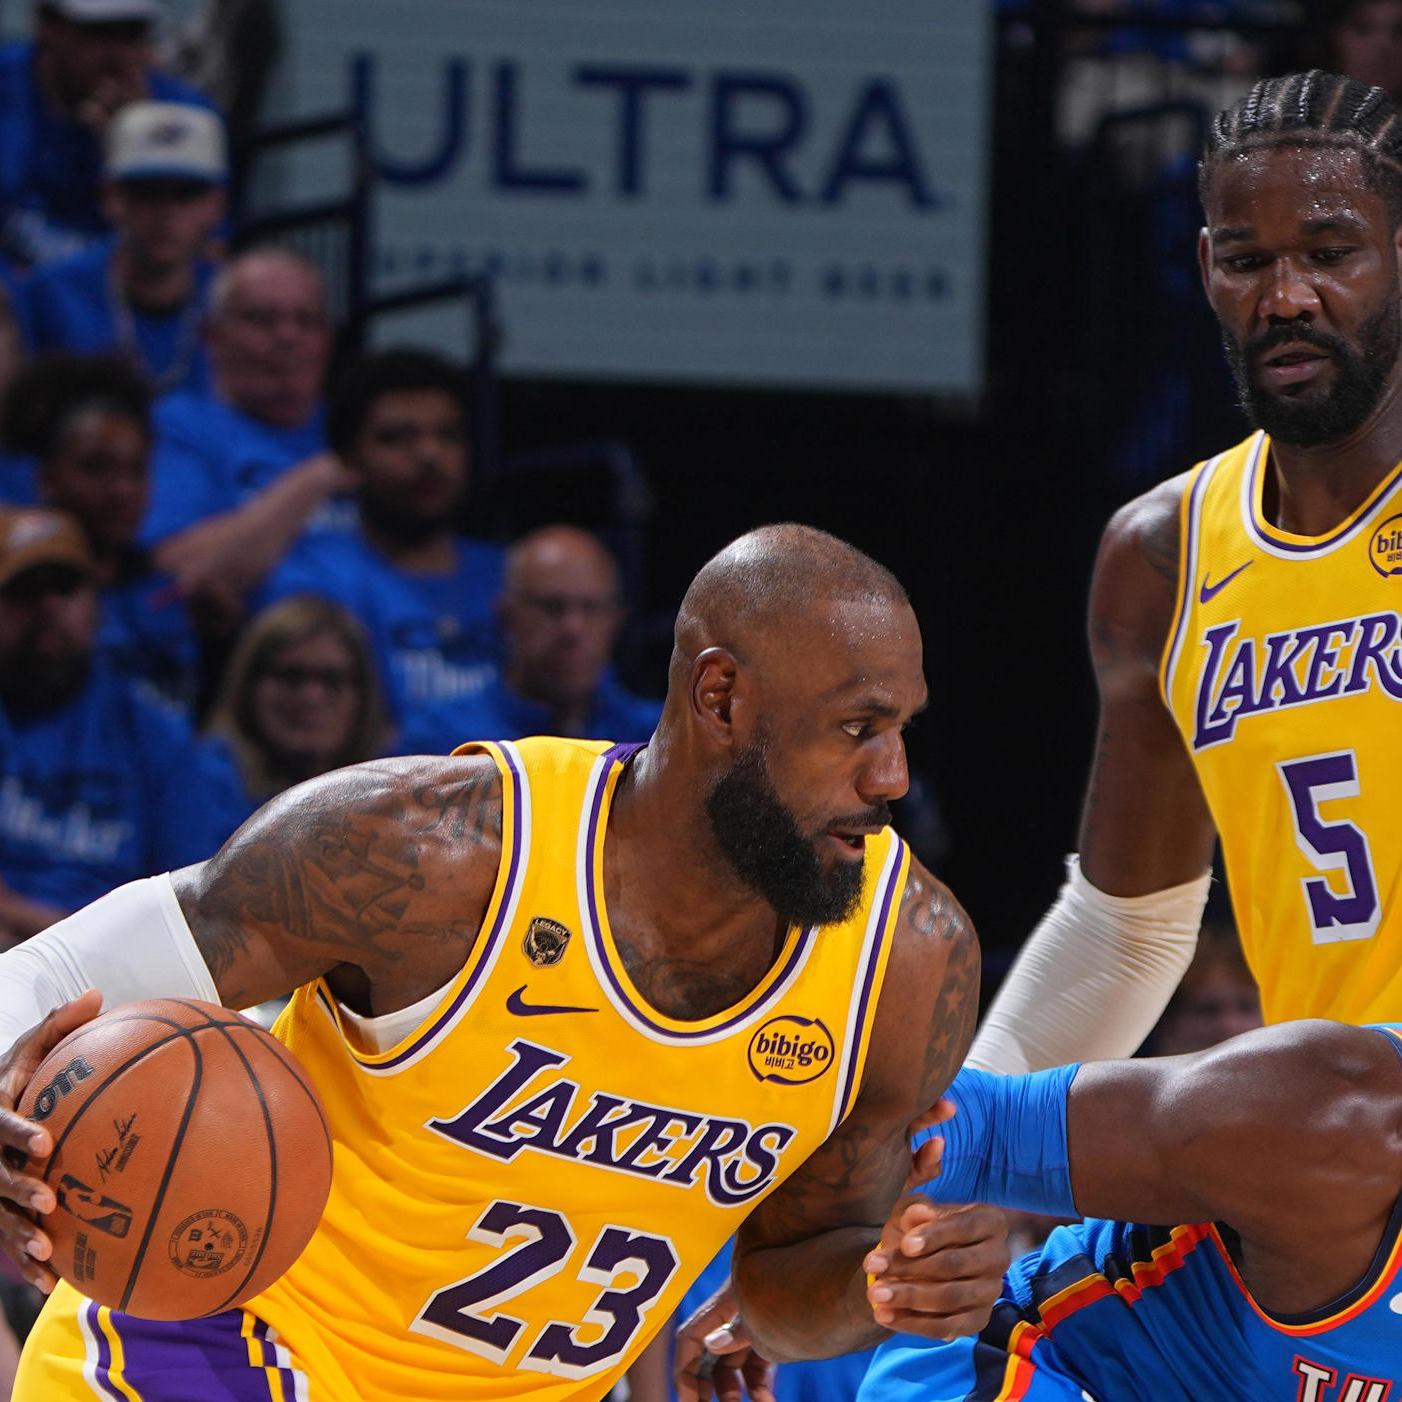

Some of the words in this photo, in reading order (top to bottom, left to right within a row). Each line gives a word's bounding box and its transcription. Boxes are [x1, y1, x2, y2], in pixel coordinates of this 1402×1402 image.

[349, 52, 936, 212] ULTRA
[1277, 749, 1382, 944] 5
[534, 918, 568, 936] LEGACY
[423, 1038, 796, 1209] LAKERS
[756, 1032, 829, 1067] bibigo
[764, 1056, 795, 1070] 비비고
[409, 1198, 682, 1382] 23
